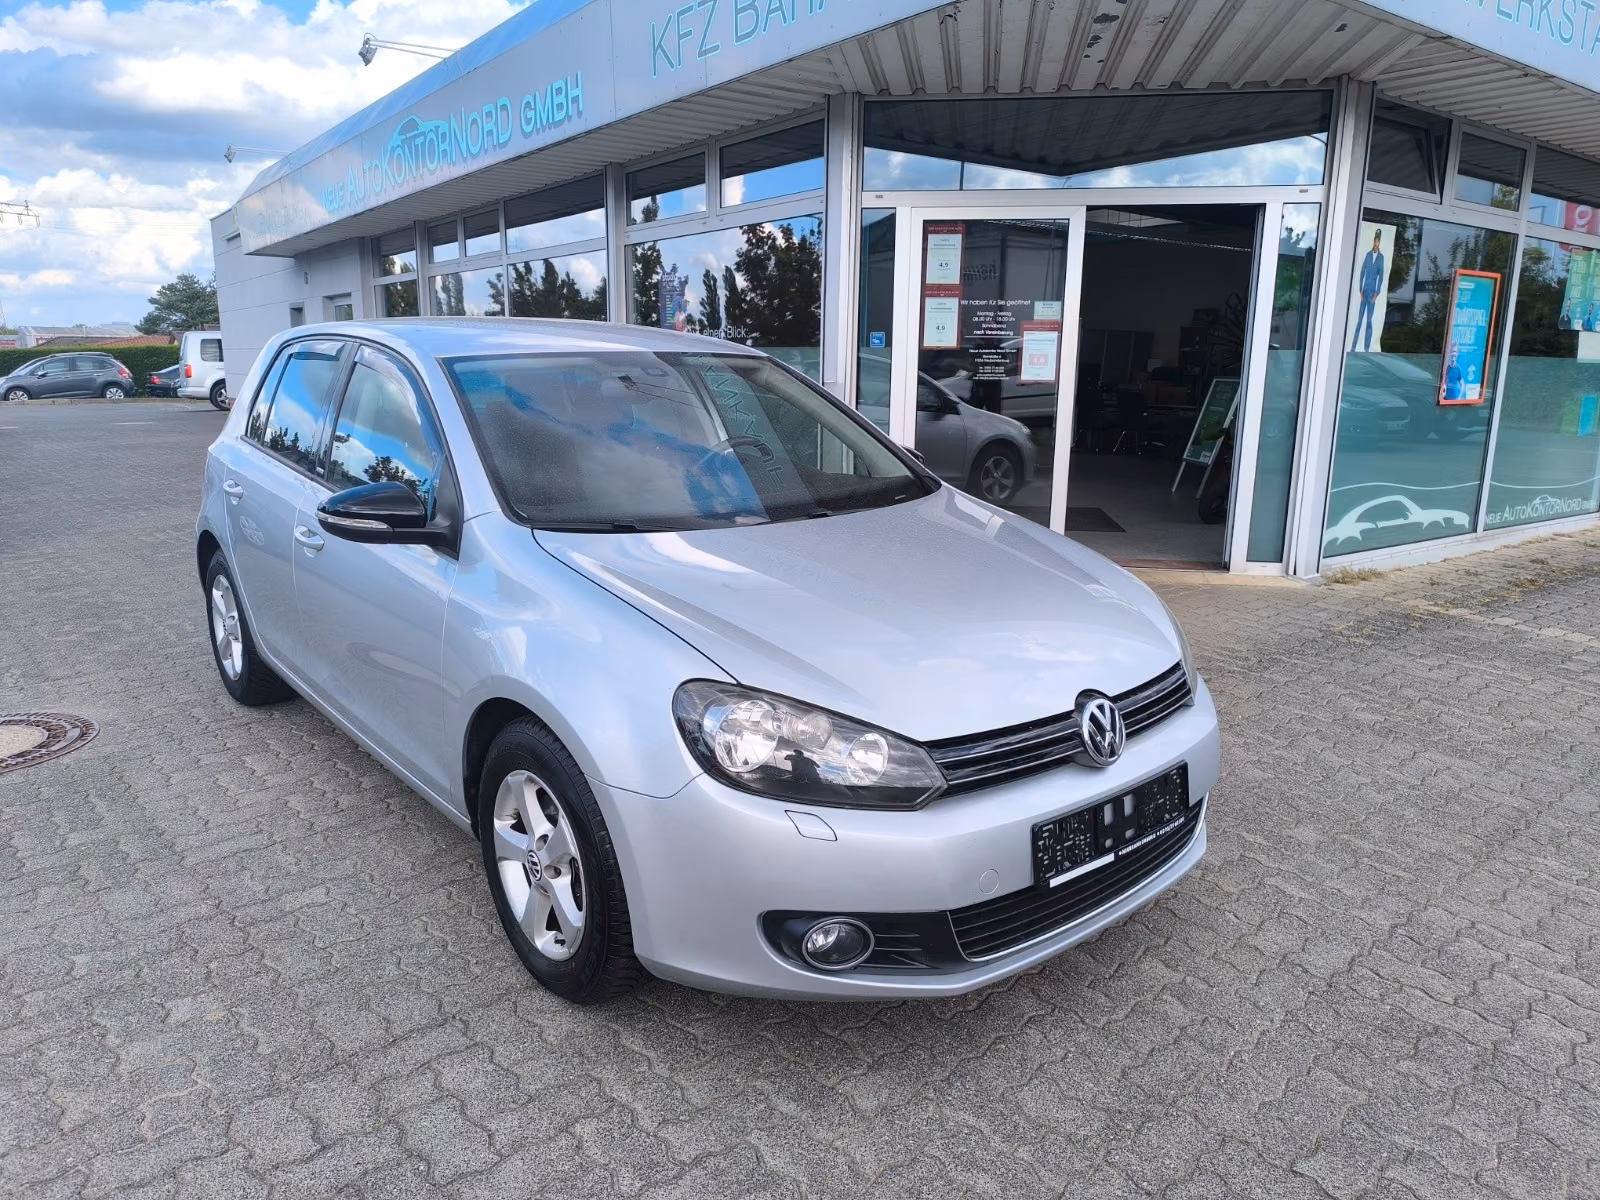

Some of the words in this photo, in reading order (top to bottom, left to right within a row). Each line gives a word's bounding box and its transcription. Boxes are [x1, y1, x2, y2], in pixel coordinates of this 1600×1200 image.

[651, 0, 722, 78] KFZ
[320, 182, 345, 213] NEUE
[1006, 299, 1031, 307] geöffnet
